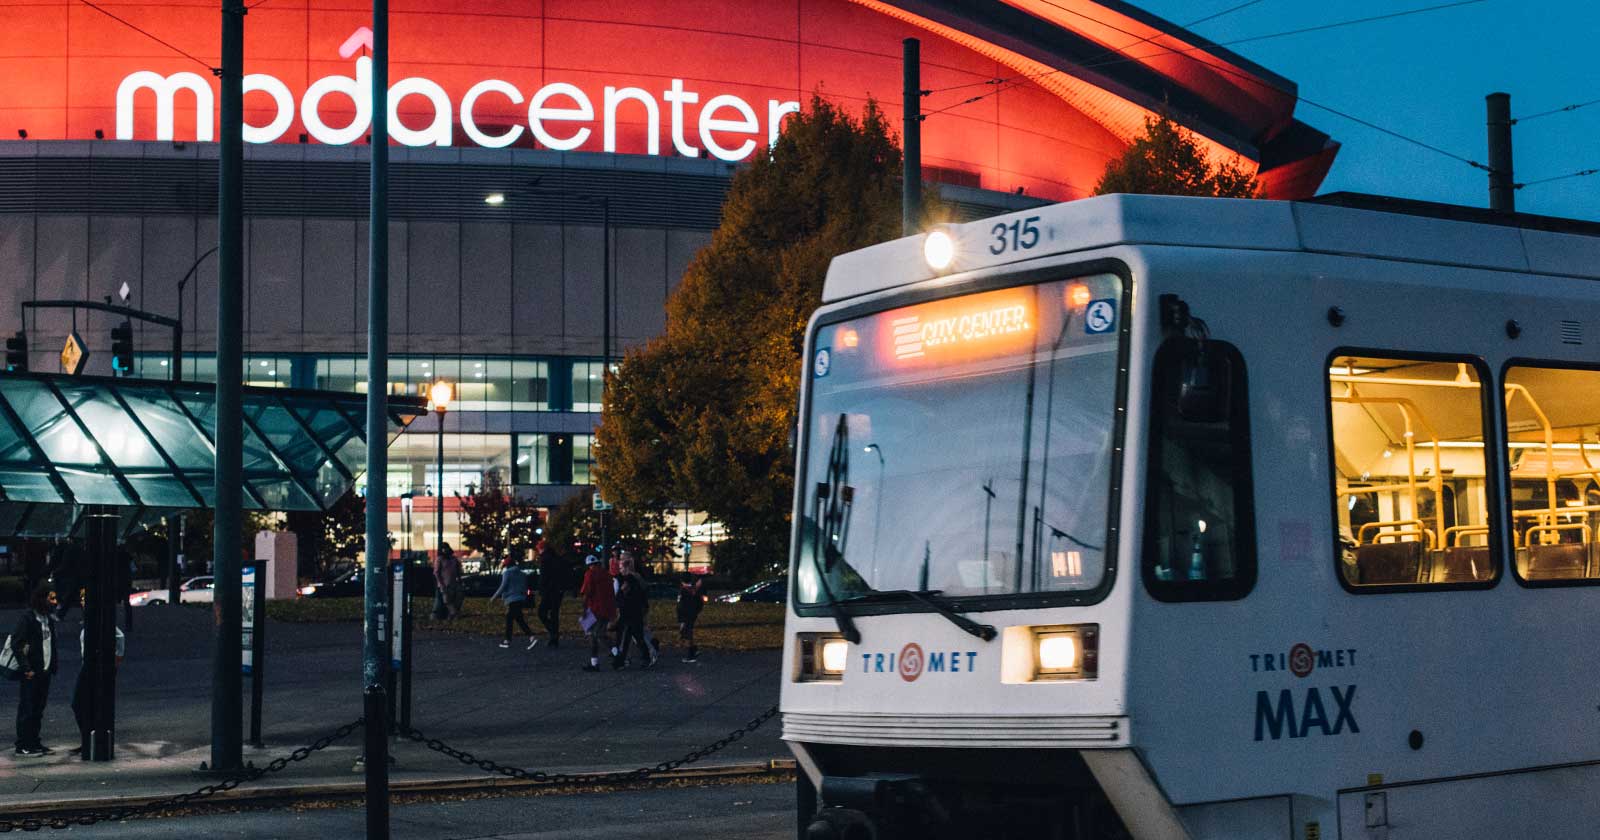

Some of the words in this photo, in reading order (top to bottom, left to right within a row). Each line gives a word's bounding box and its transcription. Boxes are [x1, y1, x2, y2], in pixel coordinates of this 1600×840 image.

[989, 215, 1041, 255] 315
[921, 317, 957, 347] CITY
[958, 304, 1030, 340] CENTER
[1253, 683, 1361, 742] MAX
